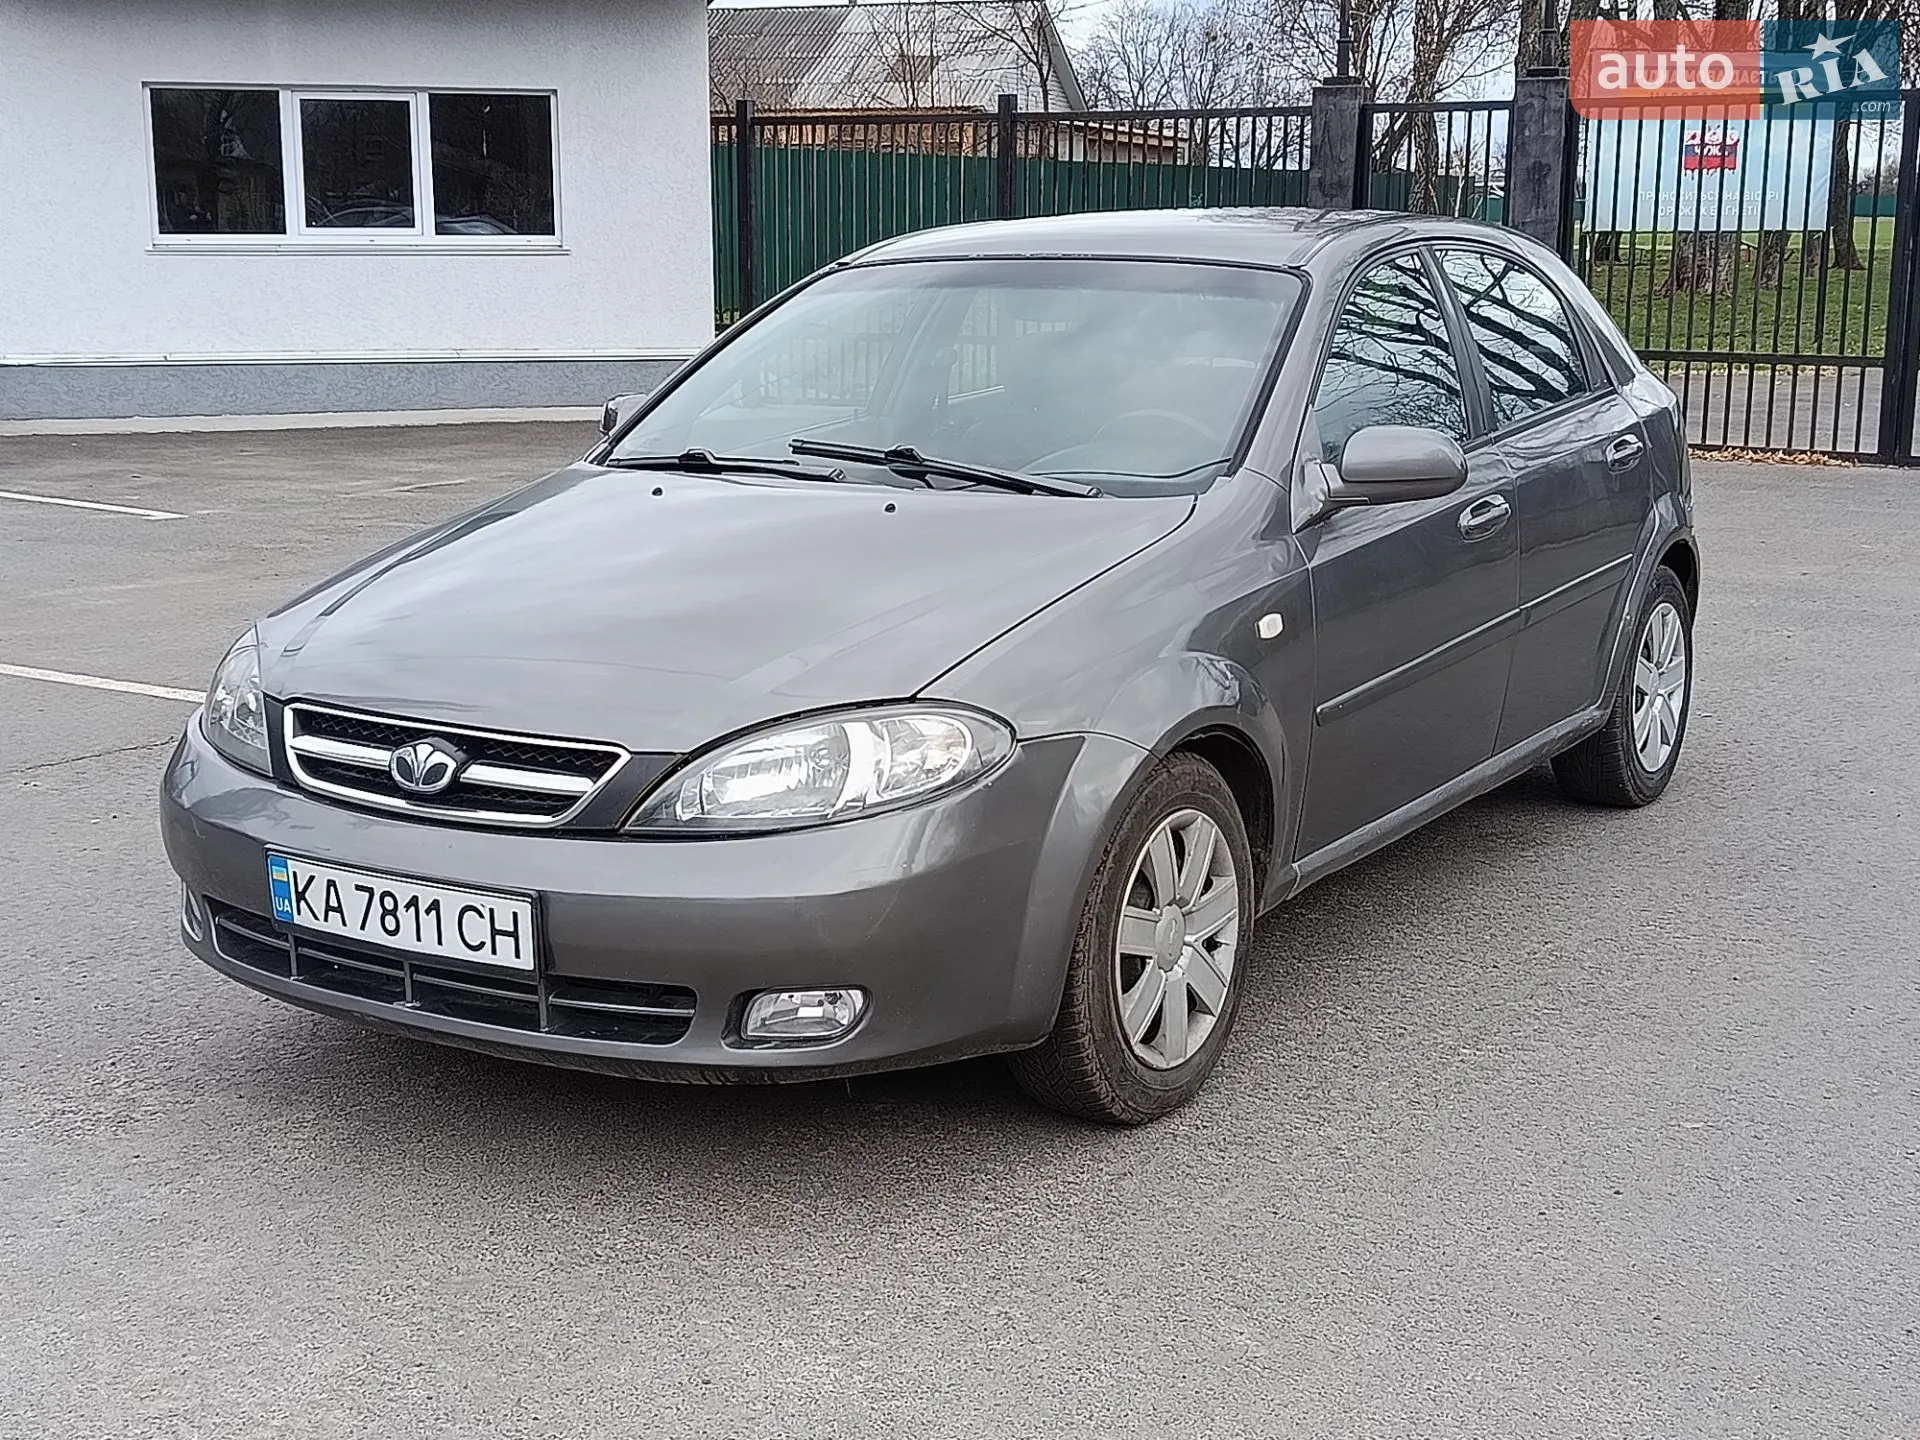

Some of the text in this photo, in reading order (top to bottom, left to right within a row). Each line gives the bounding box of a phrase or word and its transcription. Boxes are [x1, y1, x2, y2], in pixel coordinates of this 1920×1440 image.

[1744, 191, 1779, 201] ВІСРІ
[275, 898, 292, 913] UA
[292, 870, 521, 961] KA 7811 CH
